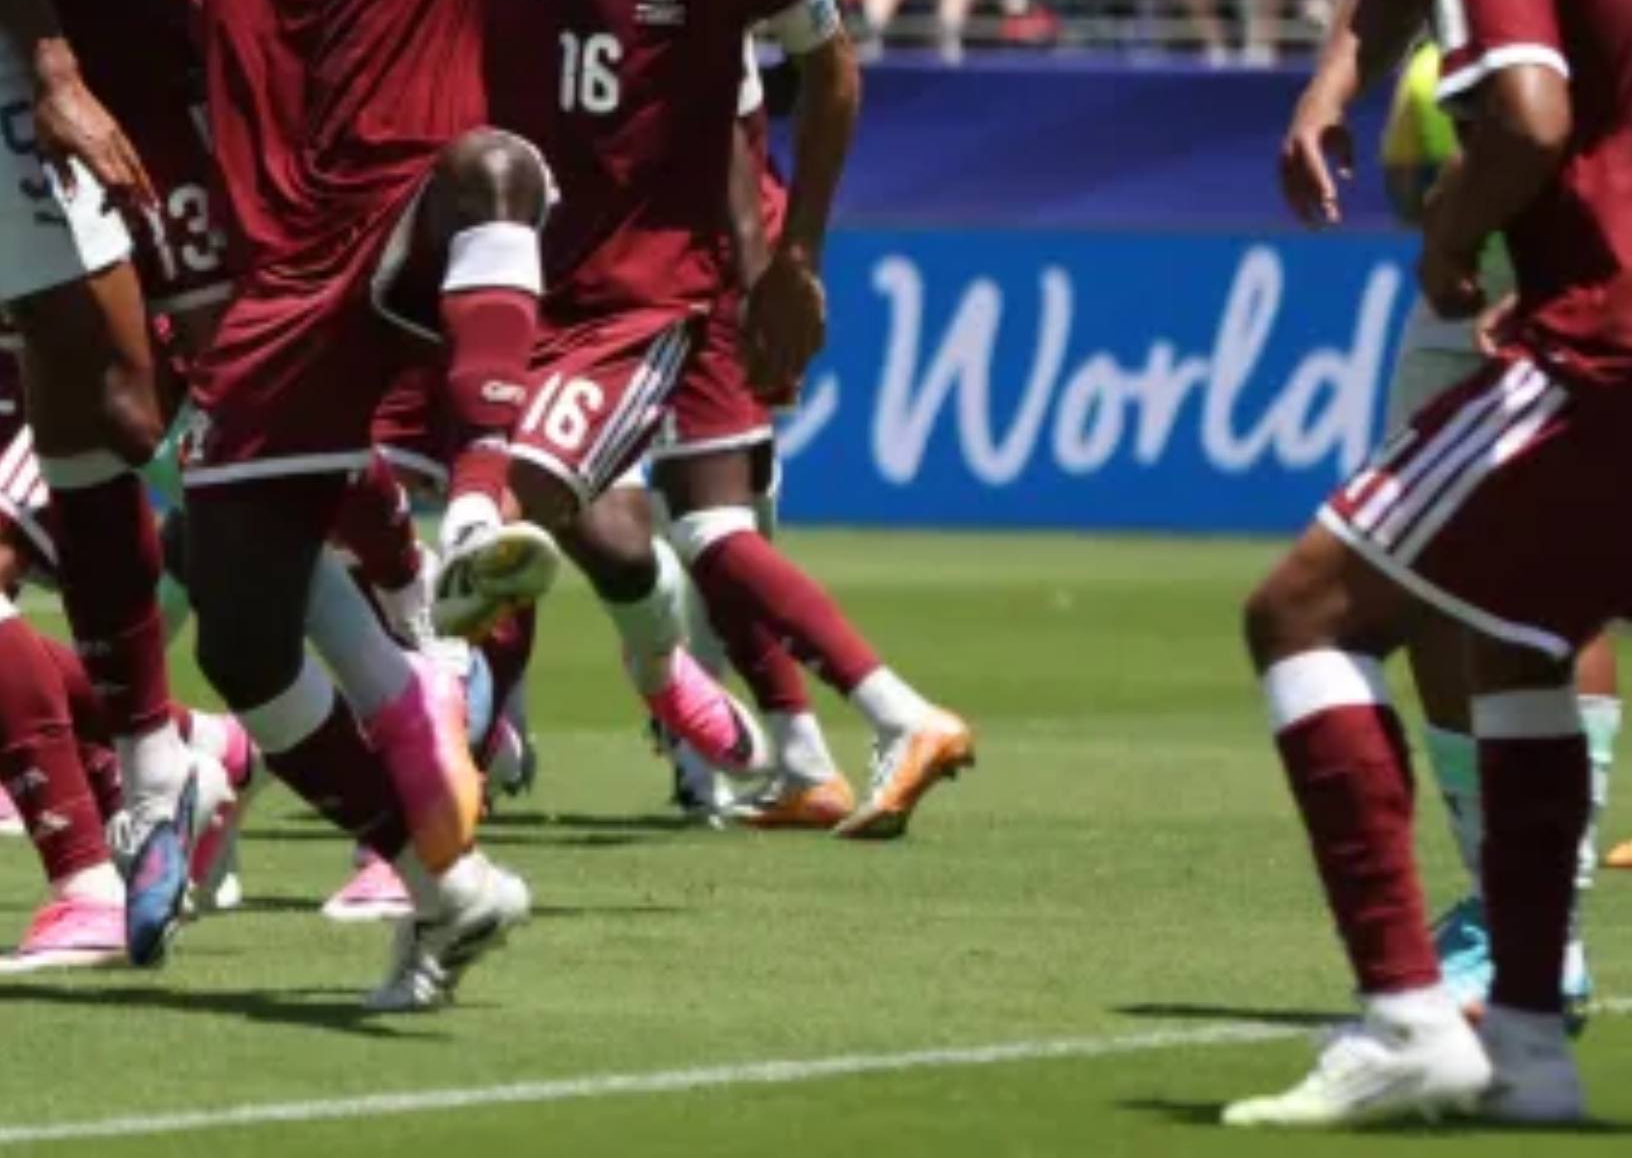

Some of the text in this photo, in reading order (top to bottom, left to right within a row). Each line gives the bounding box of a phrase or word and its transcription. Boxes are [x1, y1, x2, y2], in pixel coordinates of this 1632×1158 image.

[558, 32, 622, 114] 16
[873, 245, 1402, 486] World
[522, 372, 604, 450] 16
